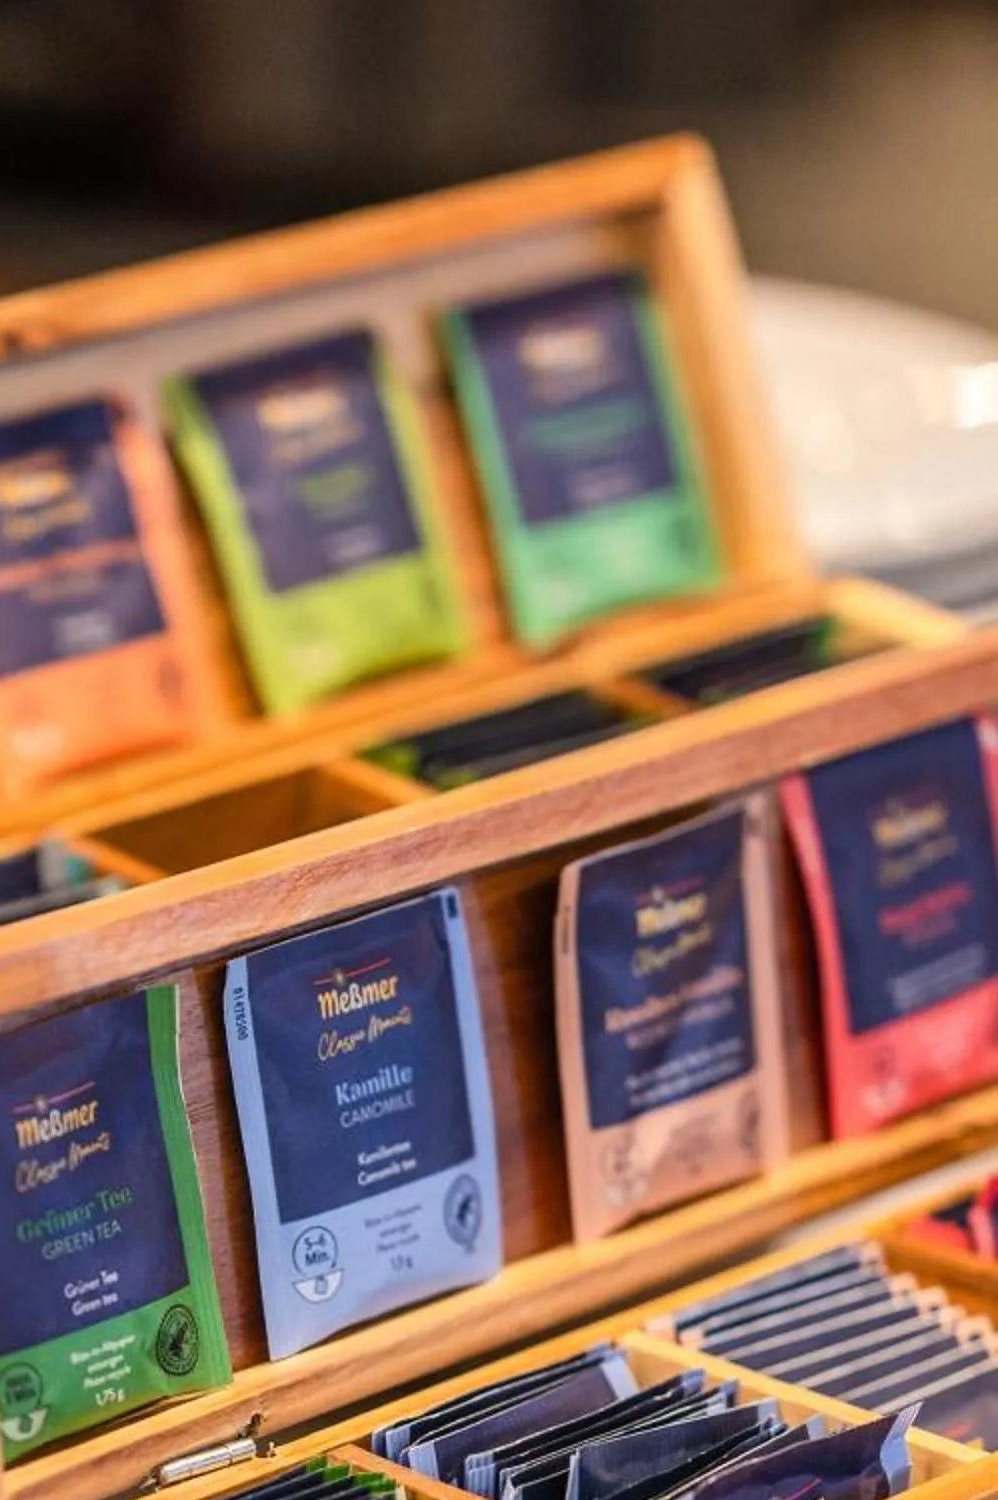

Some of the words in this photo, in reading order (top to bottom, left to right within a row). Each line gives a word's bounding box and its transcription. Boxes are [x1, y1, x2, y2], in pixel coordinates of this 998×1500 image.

[317, 975, 399, 1020] Meßmer
[335, 1065, 414, 1105] Kamille
[15, 1100, 99, 1150] Meßmer
[95, 1187, 133, 1214] Tee
[42, 1229, 96, 1260] GREEN
[95, 1219, 122, 1240] TEA
[305, 1251, 331, 1267] Min.
